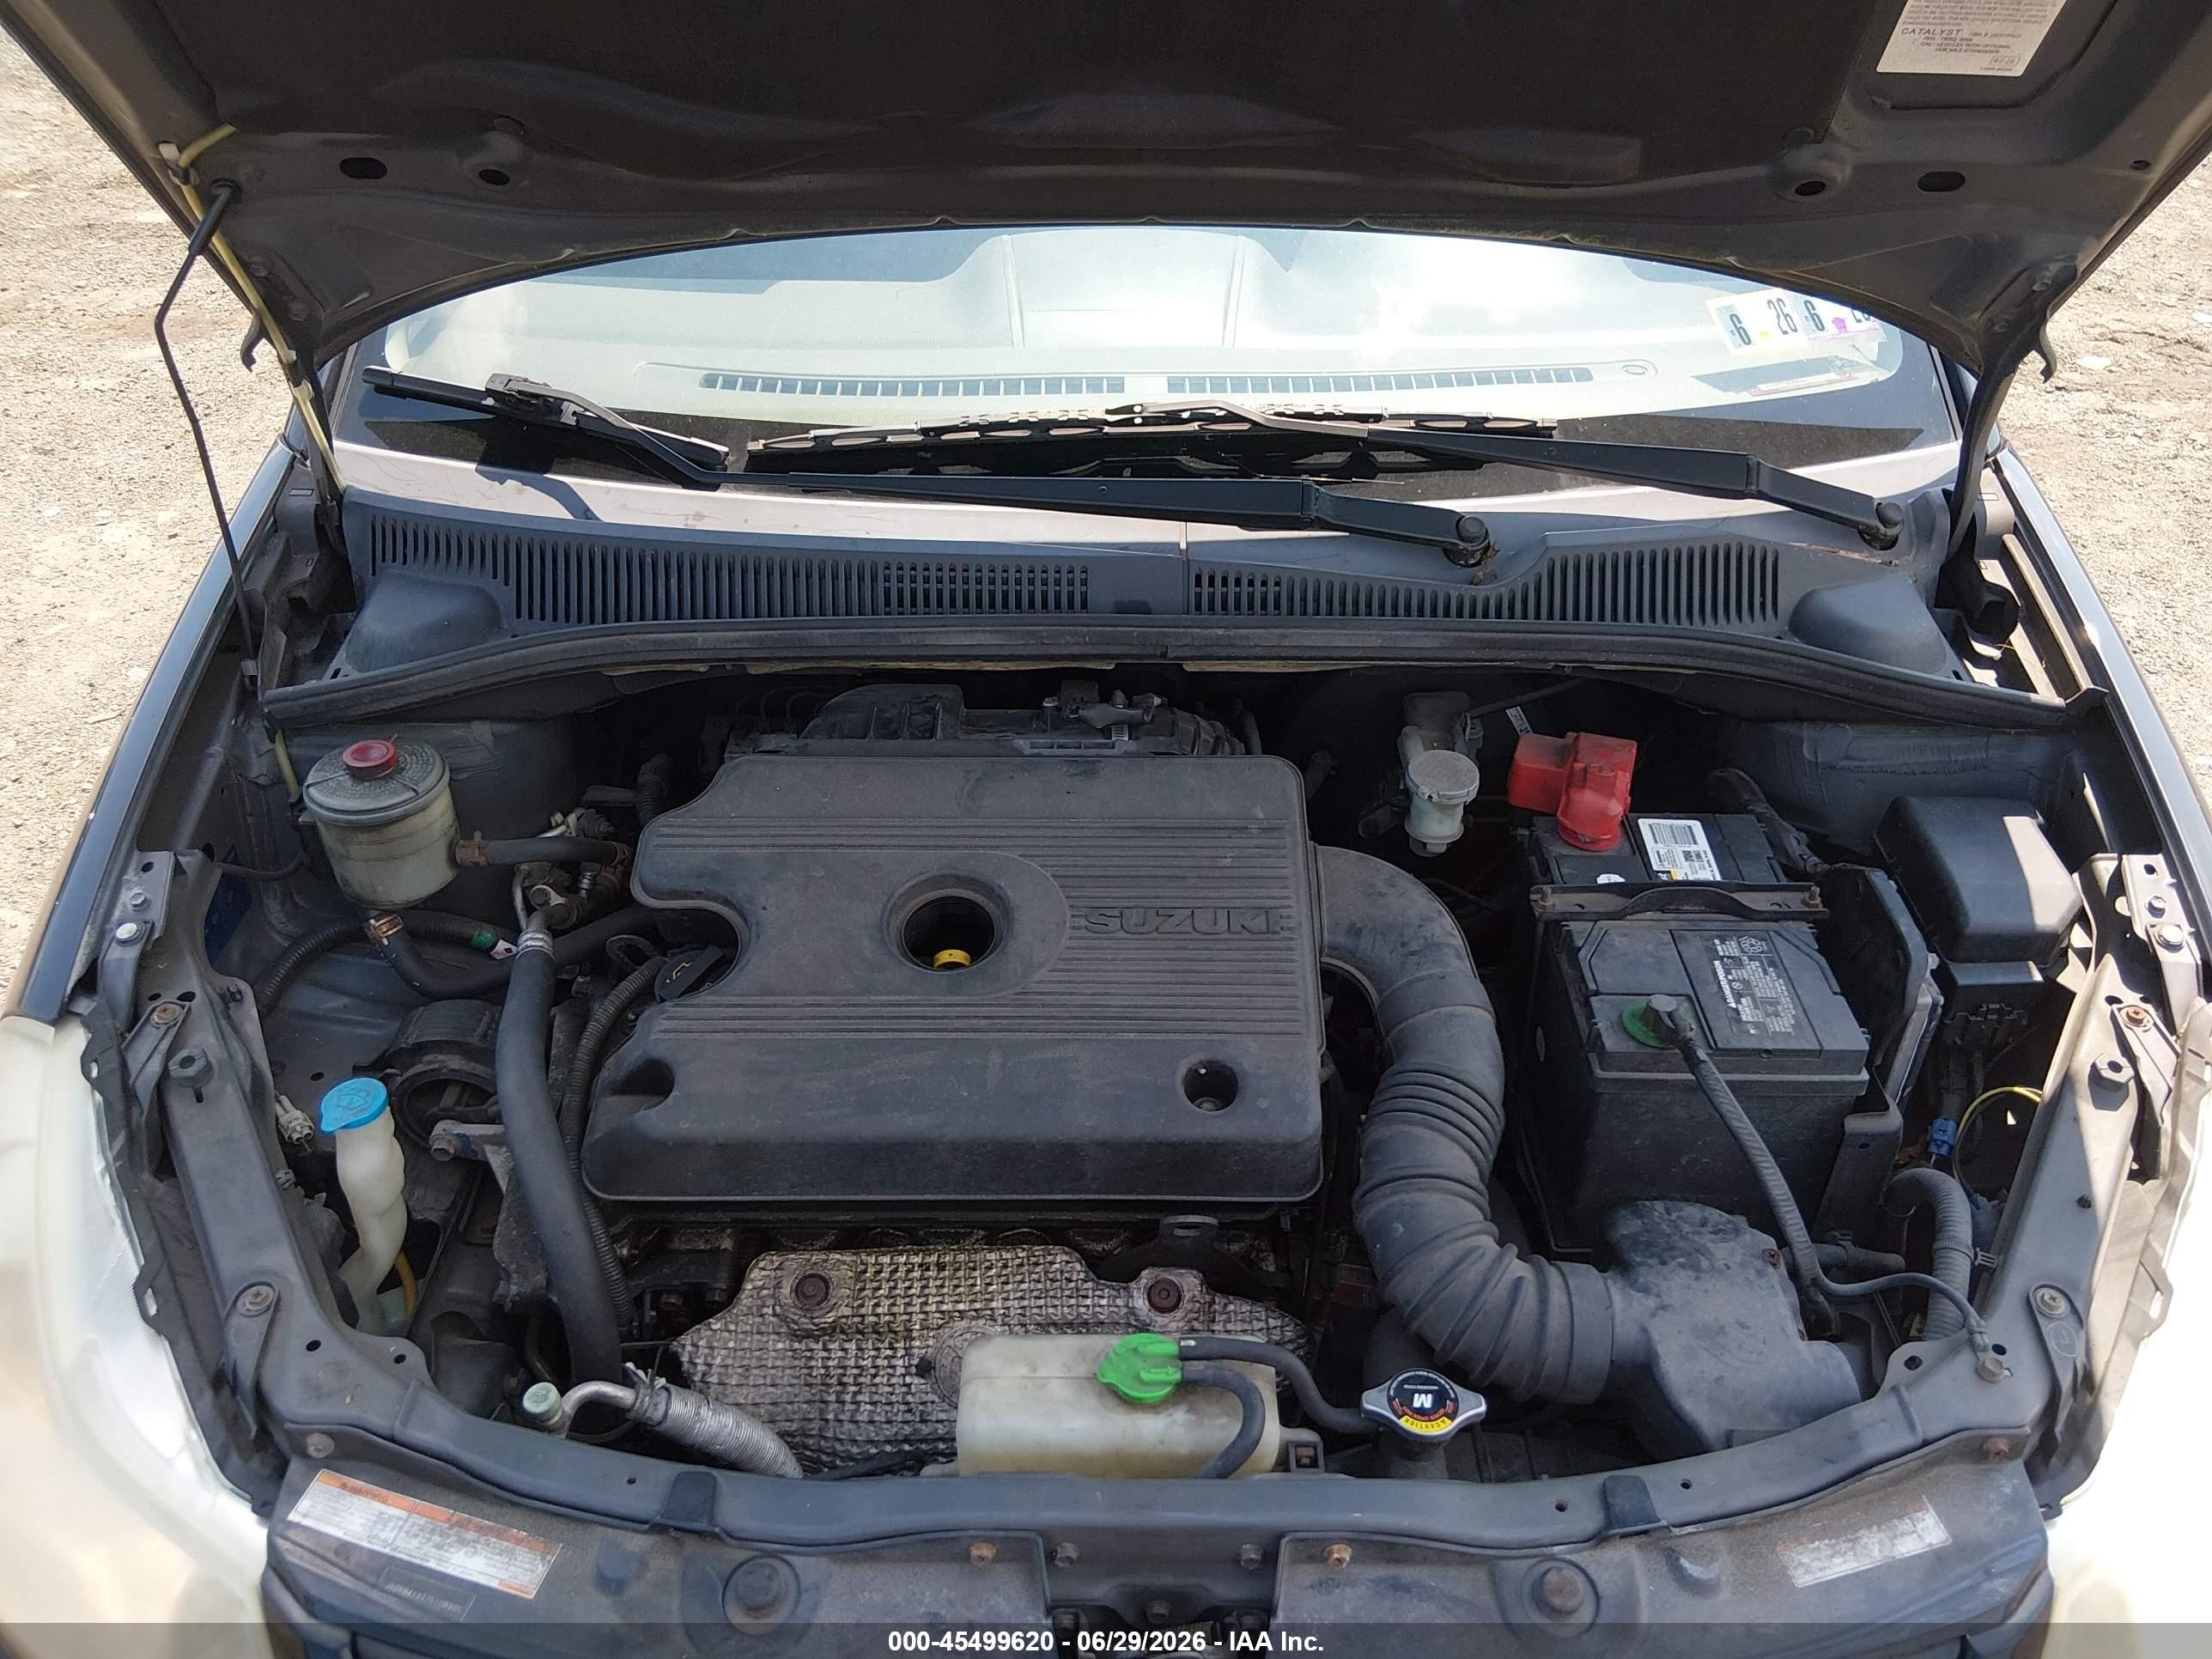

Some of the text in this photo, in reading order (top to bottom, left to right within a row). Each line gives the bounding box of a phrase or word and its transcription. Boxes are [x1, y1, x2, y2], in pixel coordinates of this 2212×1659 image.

[1901, 27, 1963, 36] CATALYST
[1729, 298, 1798, 345] 6 26
[1804, 300, 1826, 331] 6
[1085, 909, 1280, 935] SUZUKI
[1413, 1393, 1432, 1408] M
